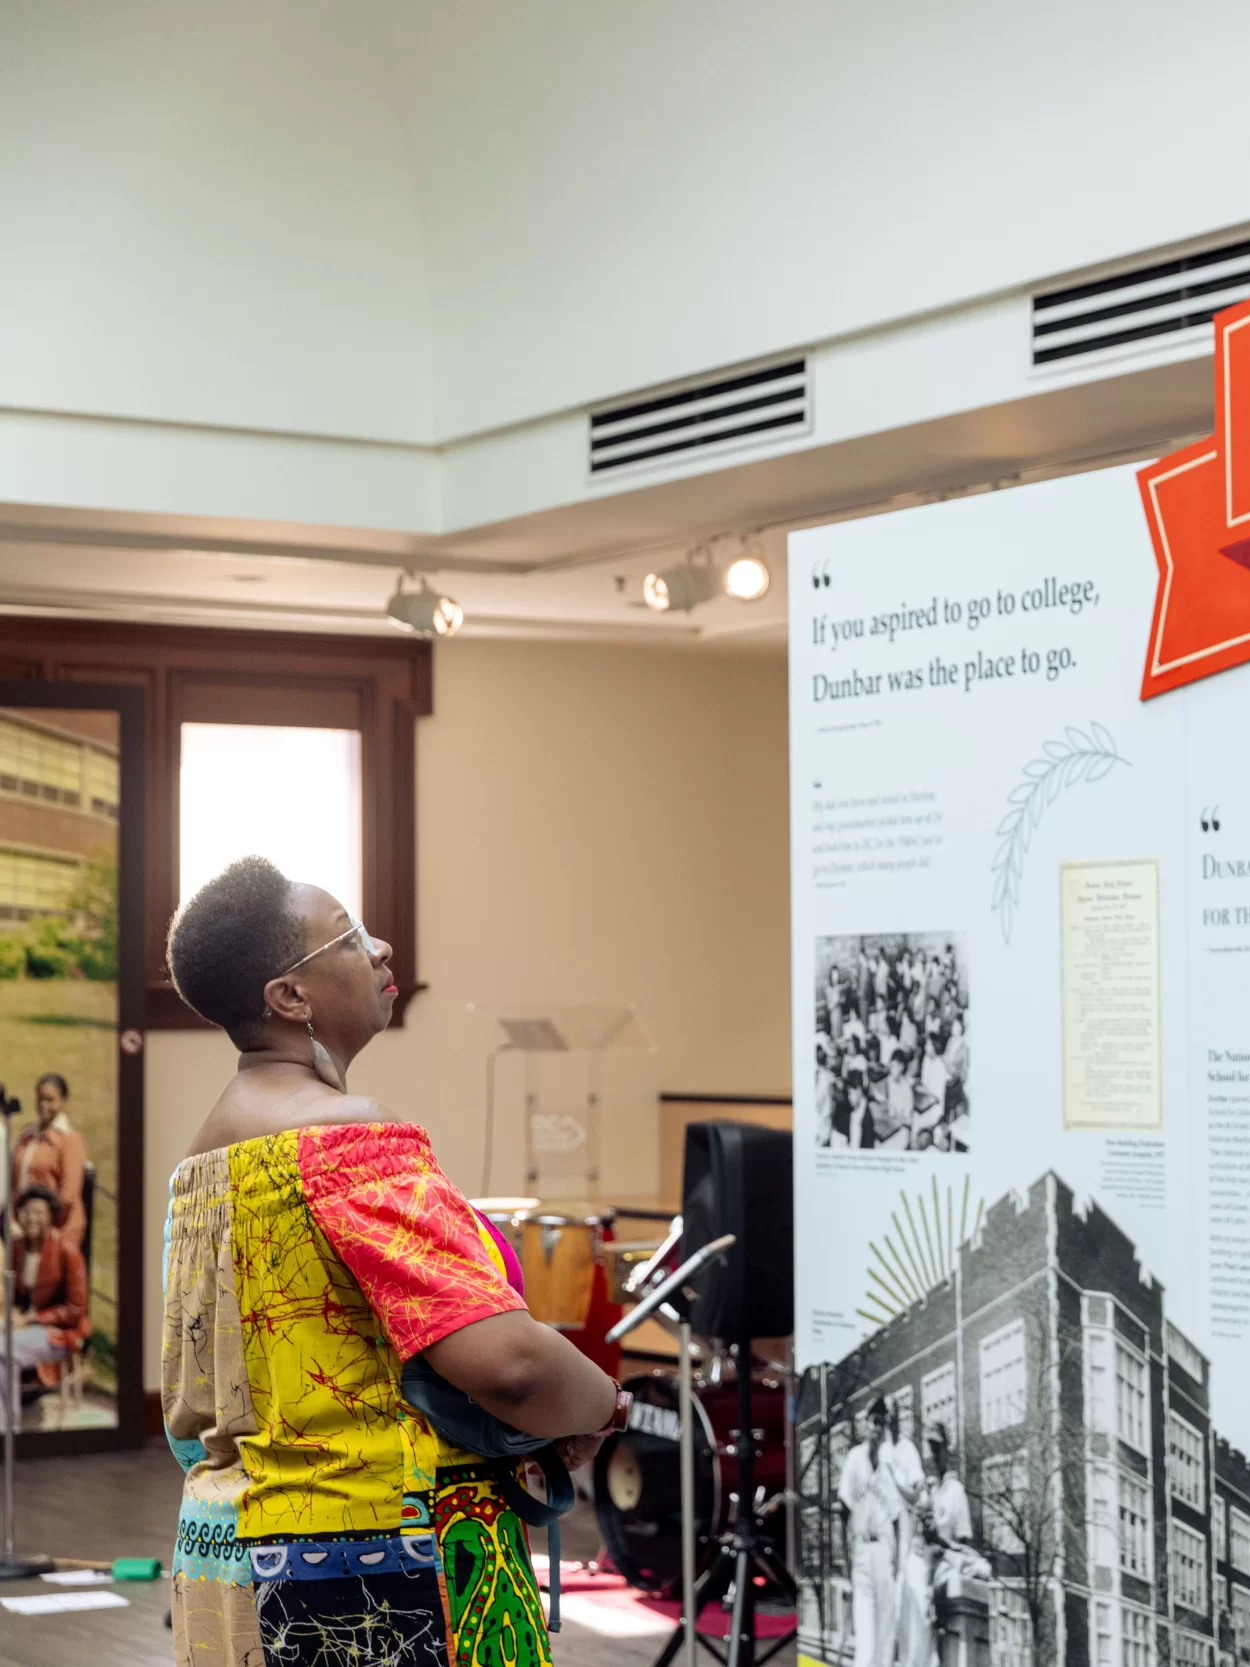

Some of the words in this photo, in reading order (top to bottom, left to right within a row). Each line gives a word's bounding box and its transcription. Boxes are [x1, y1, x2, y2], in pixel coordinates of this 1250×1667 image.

[813, 615, 826, 644] If
[832, 618, 864, 650] you
[869, 598, 938, 641] aspired
[943, 601, 962, 624] to
[967, 599, 991, 629] go
[996, 593, 1015, 616] to
[1021, 577, 1099, 614] college,
[813, 668, 881, 701] Dunbar
[888, 668, 923, 692] was
[928, 656, 958, 686] the
[964, 652, 1015, 690] place
[1021, 650, 1040, 674] to
[1046, 649, 1076, 679] go.
[1203, 907, 1230, 926] FOR
